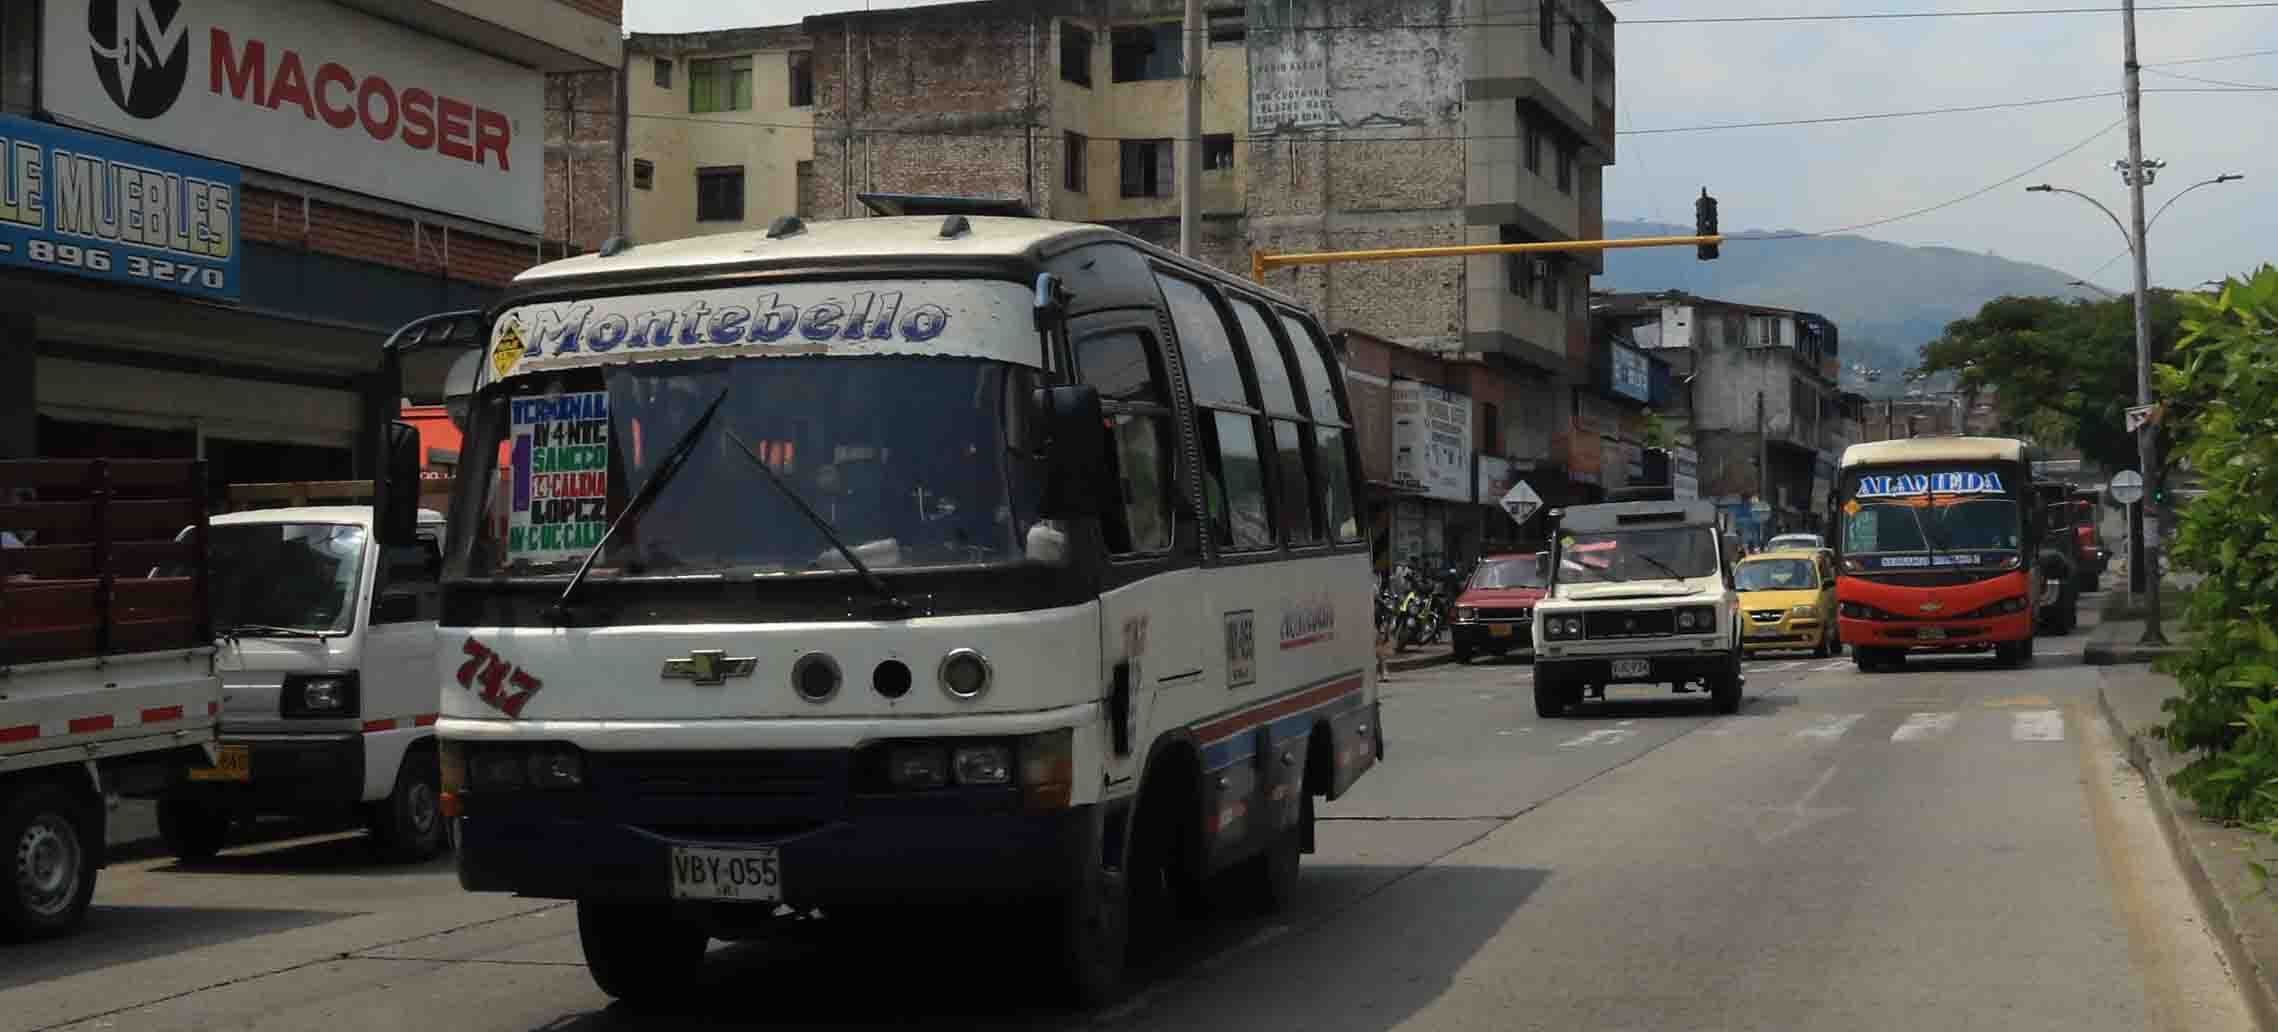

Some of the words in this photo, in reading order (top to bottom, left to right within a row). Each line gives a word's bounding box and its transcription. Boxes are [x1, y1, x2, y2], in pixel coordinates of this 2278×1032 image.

[208, 26, 511, 171] MACOSER
[53, 149, 233, 261] MUEBLES
[28, 239, 112, 271] 896
[128, 255, 223, 288] 3270
[524, 290, 949, 358] Montebello
[456, 636, 544, 720] 747
[674, 855, 777, 887] VBY-055
